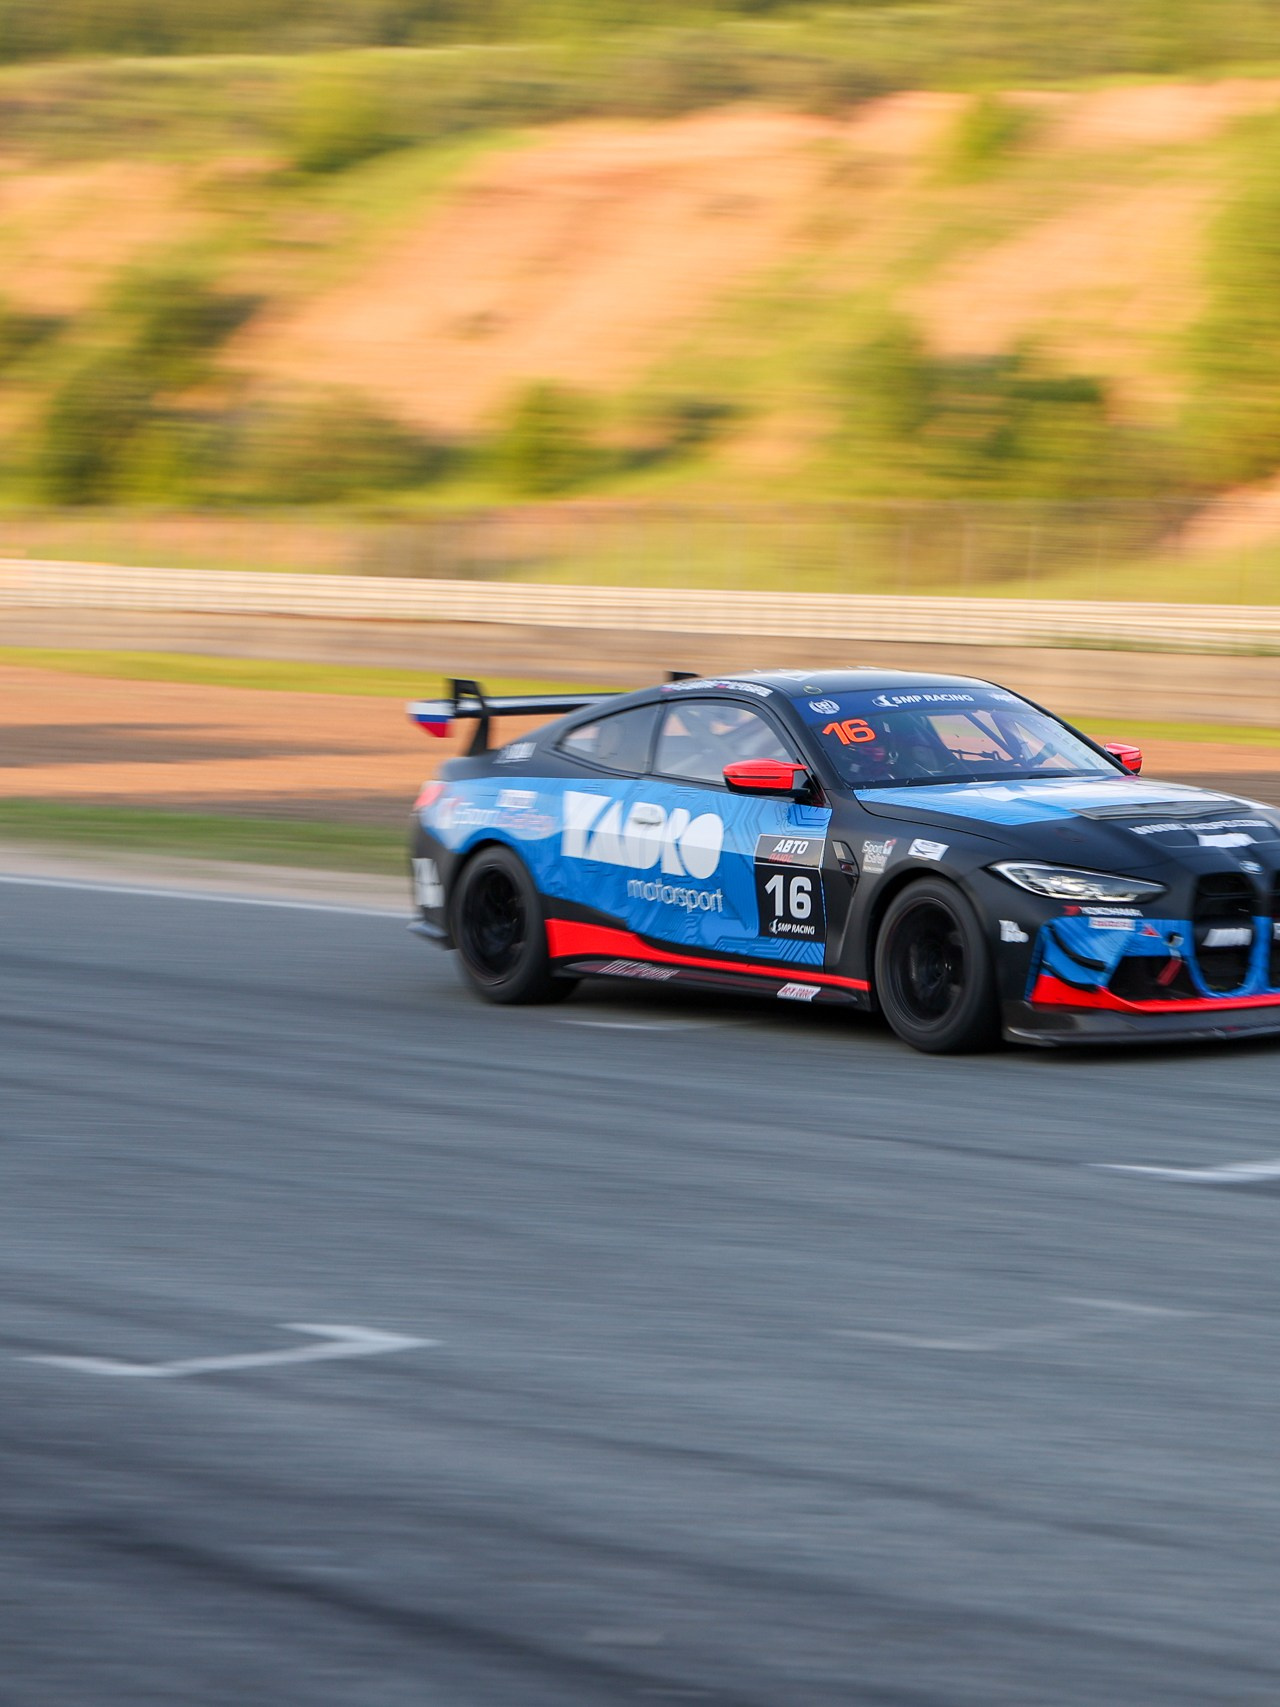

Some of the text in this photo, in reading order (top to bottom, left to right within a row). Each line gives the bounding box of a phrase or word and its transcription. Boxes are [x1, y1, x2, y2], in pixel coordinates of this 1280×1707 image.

[894, 693, 974, 706] SMP RACING
[822, 719, 876, 746] 16
[627, 879, 724, 913] motorsport
[764, 874, 812, 920] 16
[777, 922, 815, 936] SMP RACING
